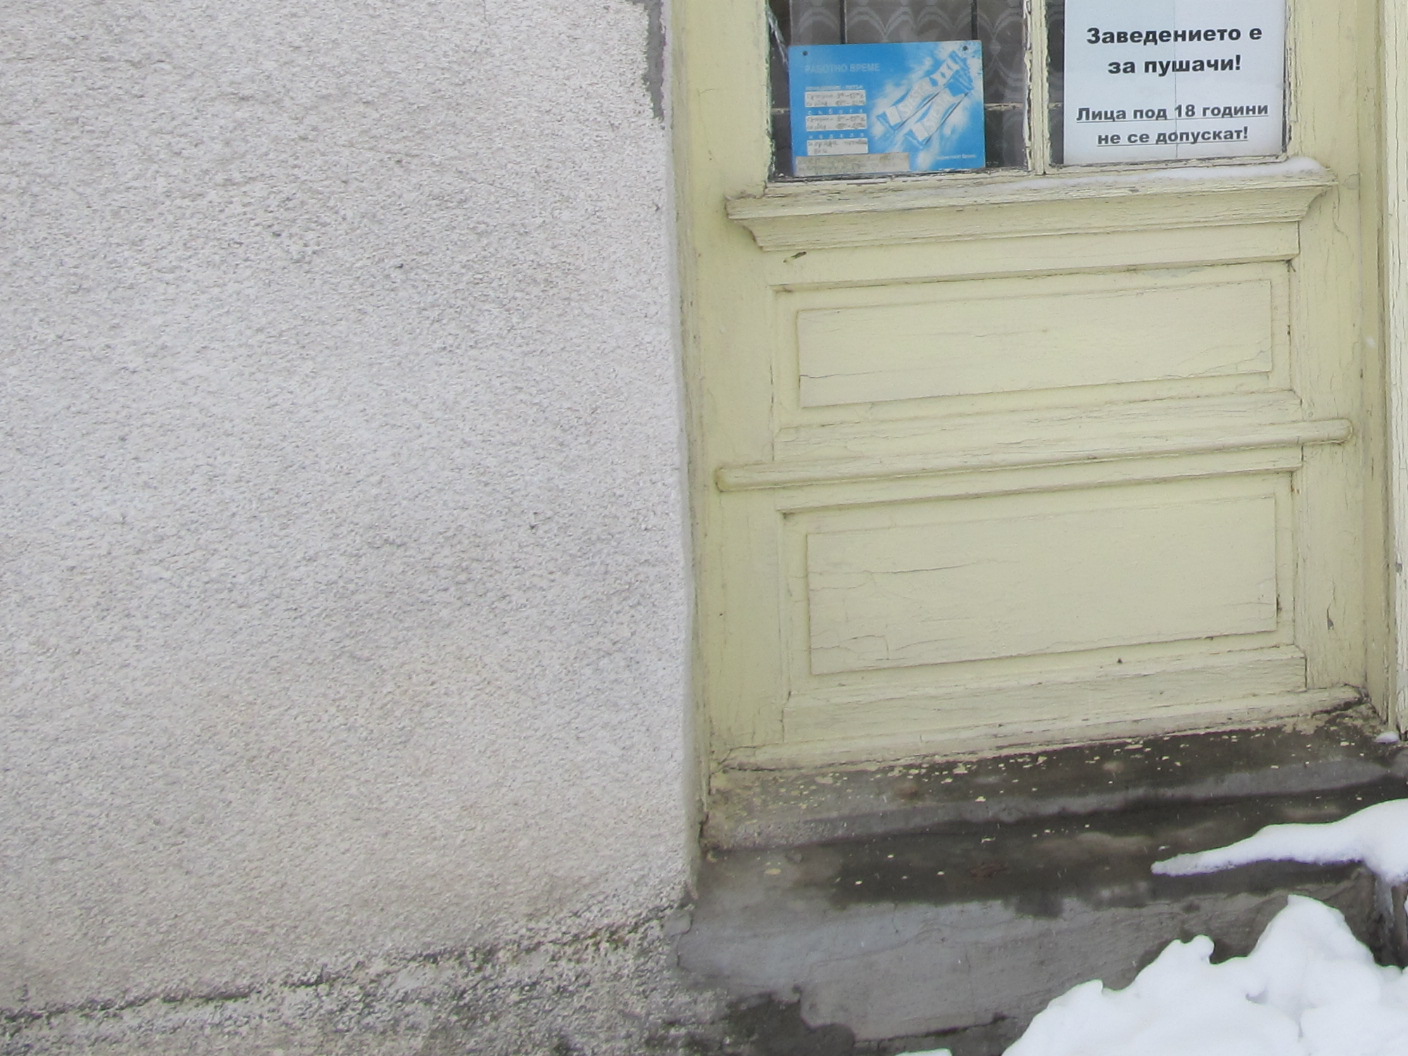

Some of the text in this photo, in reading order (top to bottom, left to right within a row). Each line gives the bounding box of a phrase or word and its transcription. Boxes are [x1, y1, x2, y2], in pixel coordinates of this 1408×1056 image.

[1086, 27, 1263, 46] Заведението е
[1107, 54, 1241, 77] за пушачи!
[1076, 103, 1269, 122] Лица под 18 години
[1097, 126, 1249, 145] не се допускат!
